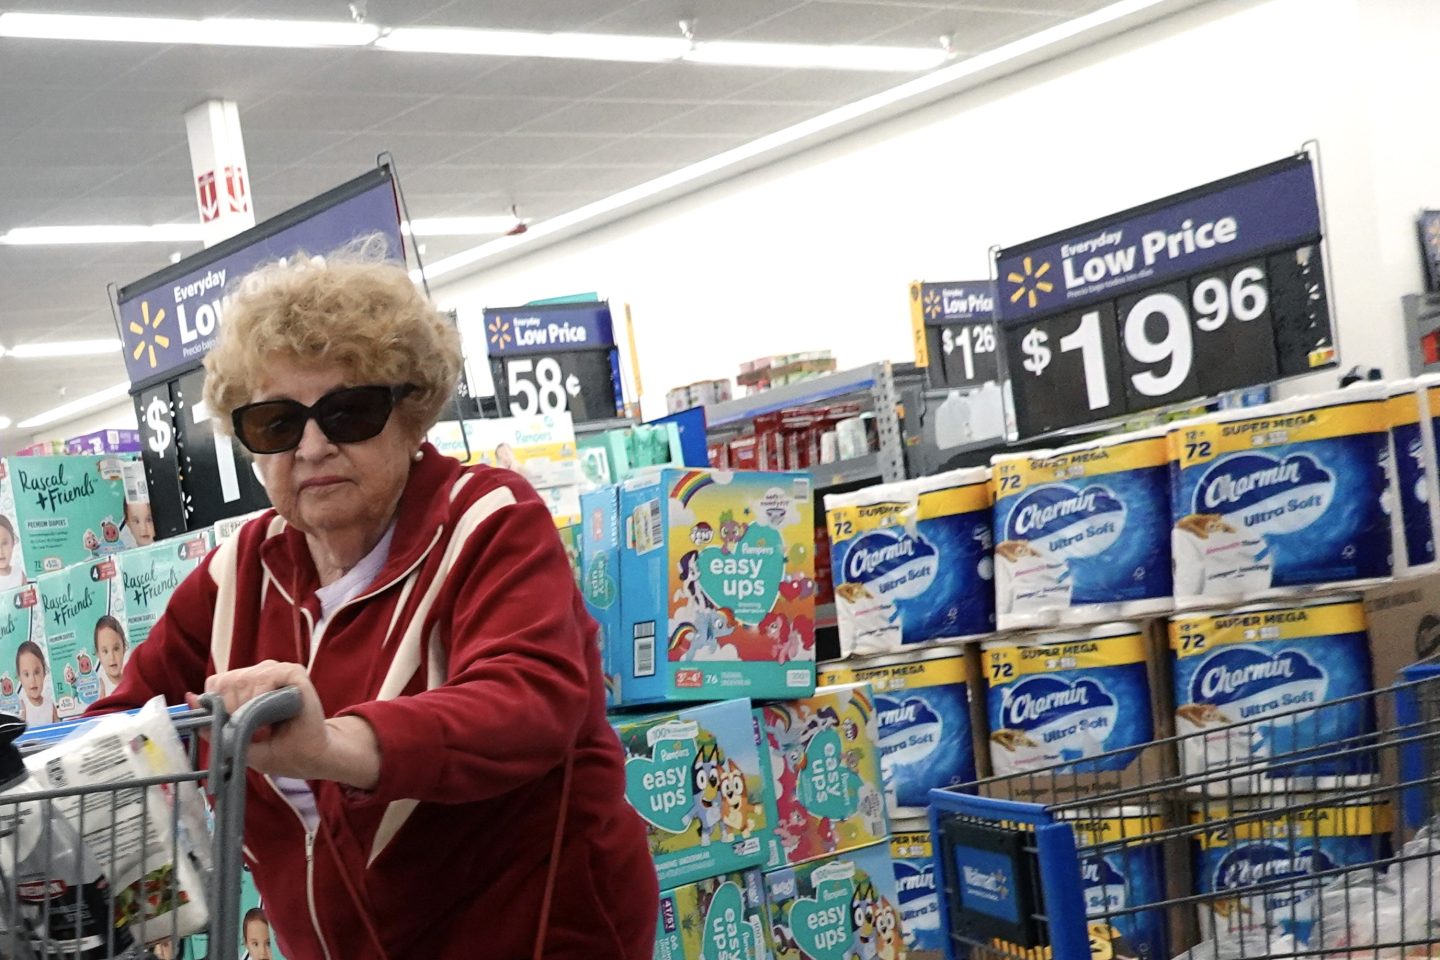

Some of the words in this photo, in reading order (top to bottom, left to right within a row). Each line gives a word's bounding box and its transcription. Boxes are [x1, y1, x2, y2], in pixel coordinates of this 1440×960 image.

[1061, 228, 1122, 259] Everyday
[1063, 245, 1138, 290] Low
[1143, 215, 1237, 266] Price
[174, 268, 226, 304] Everyday
[944, 298, 968, 315] Low
[515, 325, 546, 346] Low
[548, 321, 587, 343] Price
[183, 343, 202, 358] Precio
[515, 430, 552, 445] Pampers
[1222, 421, 1269, 437] SUPER
[1274, 412, 1317, 430] MEGA
[1185, 440, 1212, 459] 72
[18, 464, 68, 493] Rascal
[1000, 474, 1022, 491] 72
[1205, 459, 1300, 509] Charmin
[35, 473, 95, 513] +Friends
[1015, 490, 1096, 535] Charmin
[1244, 506, 1284, 527] Ultra
[1287, 493, 1322, 513] Soft
[27, 519, 46, 529] PREMIUM
[47, 518, 66, 527] DIAPERS
[835, 521, 852, 535] 72
[1049, 533, 1084, 552] Ultra
[1087, 521, 1115, 537] Soft
[180, 543, 187, 558] 4
[850, 534, 914, 579] Charmin
[34, 561, 42, 570] 72
[92, 568, 98, 580] 4
[123, 561, 157, 591] Rascal
[710, 557, 763, 579] easy
[134, 570, 179, 607] +Friends
[723, 579, 766, 600] ups
[879, 574, 907, 594] Ultra
[907, 565, 931, 582] Soft
[15, 596, 21, 608] 4
[42, 585, 73, 612] Rascal
[53, 590, 93, 627] +Friends
[1264, 611, 1307, 625] MEGA
[1020, 648, 1060, 659] SUPER
[1062, 643, 1099, 655] MEGA
[1180, 633, 1206, 650] 72
[855, 669, 890, 681] SUPER
[892, 664, 926, 676] MEGA
[992, 663, 1013, 679] 72
[1201, 653, 1295, 699] Charmin
[1010, 683, 1089, 724] Charmin
[1240, 699, 1279, 719] Ultra
[1282, 690, 1315, 707] Soft
[908, 732, 935, 746] Soft
[1043, 725, 1077, 744] Ultra
[1079, 716, 1109, 732] Soft
[643, 765, 687, 791] easy
[811, 759, 828, 804] ups
[824, 742, 842, 798] easy
[650, 787, 687, 814] ups
[807, 904, 846, 930] easy
[814, 926, 847, 950] ups
